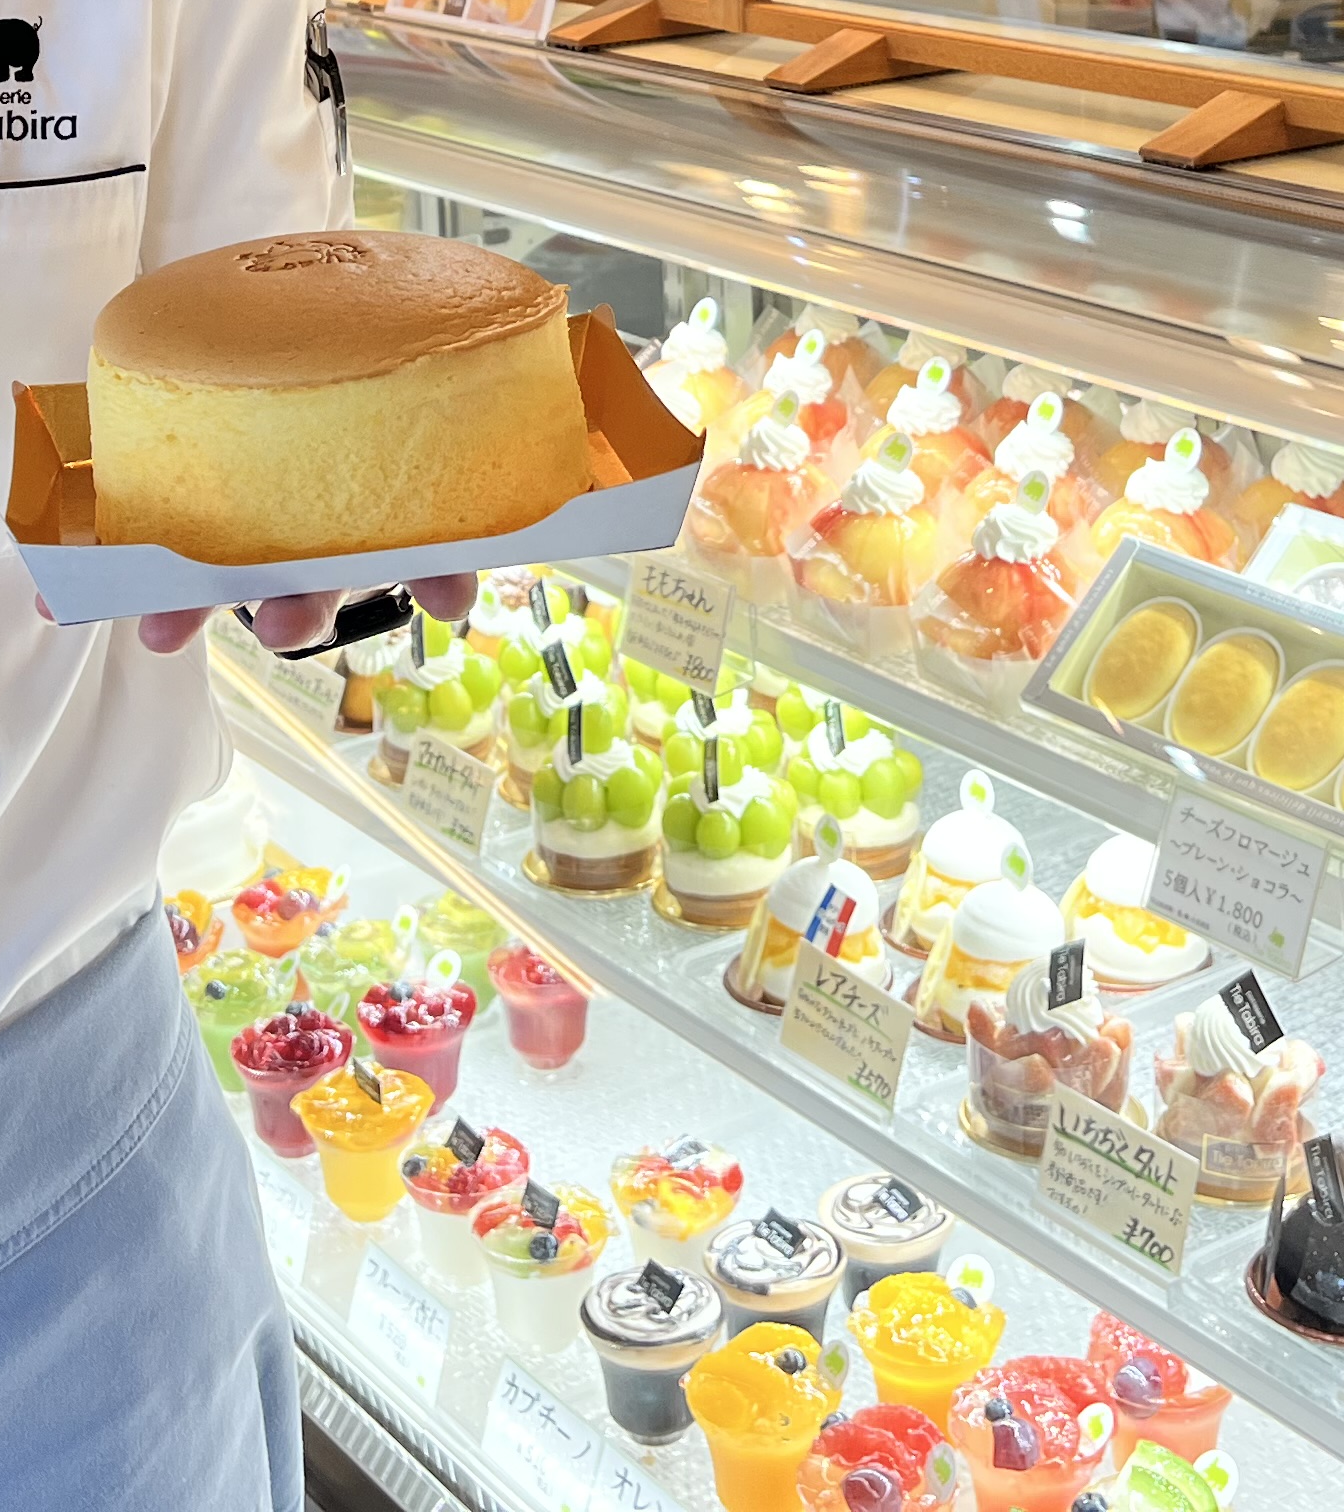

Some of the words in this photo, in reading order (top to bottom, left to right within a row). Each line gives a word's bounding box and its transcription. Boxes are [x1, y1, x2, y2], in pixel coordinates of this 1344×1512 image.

[1180, 806, 1311, 878] チーズフロマージュ
[1229, 981, 1244, 1004] Tie
[1238, 1000, 1266, 1047] Tabira
[1122, 1216, 1175, 1264] ¥700
[500, 1372, 592, 1460] カプチーノ
